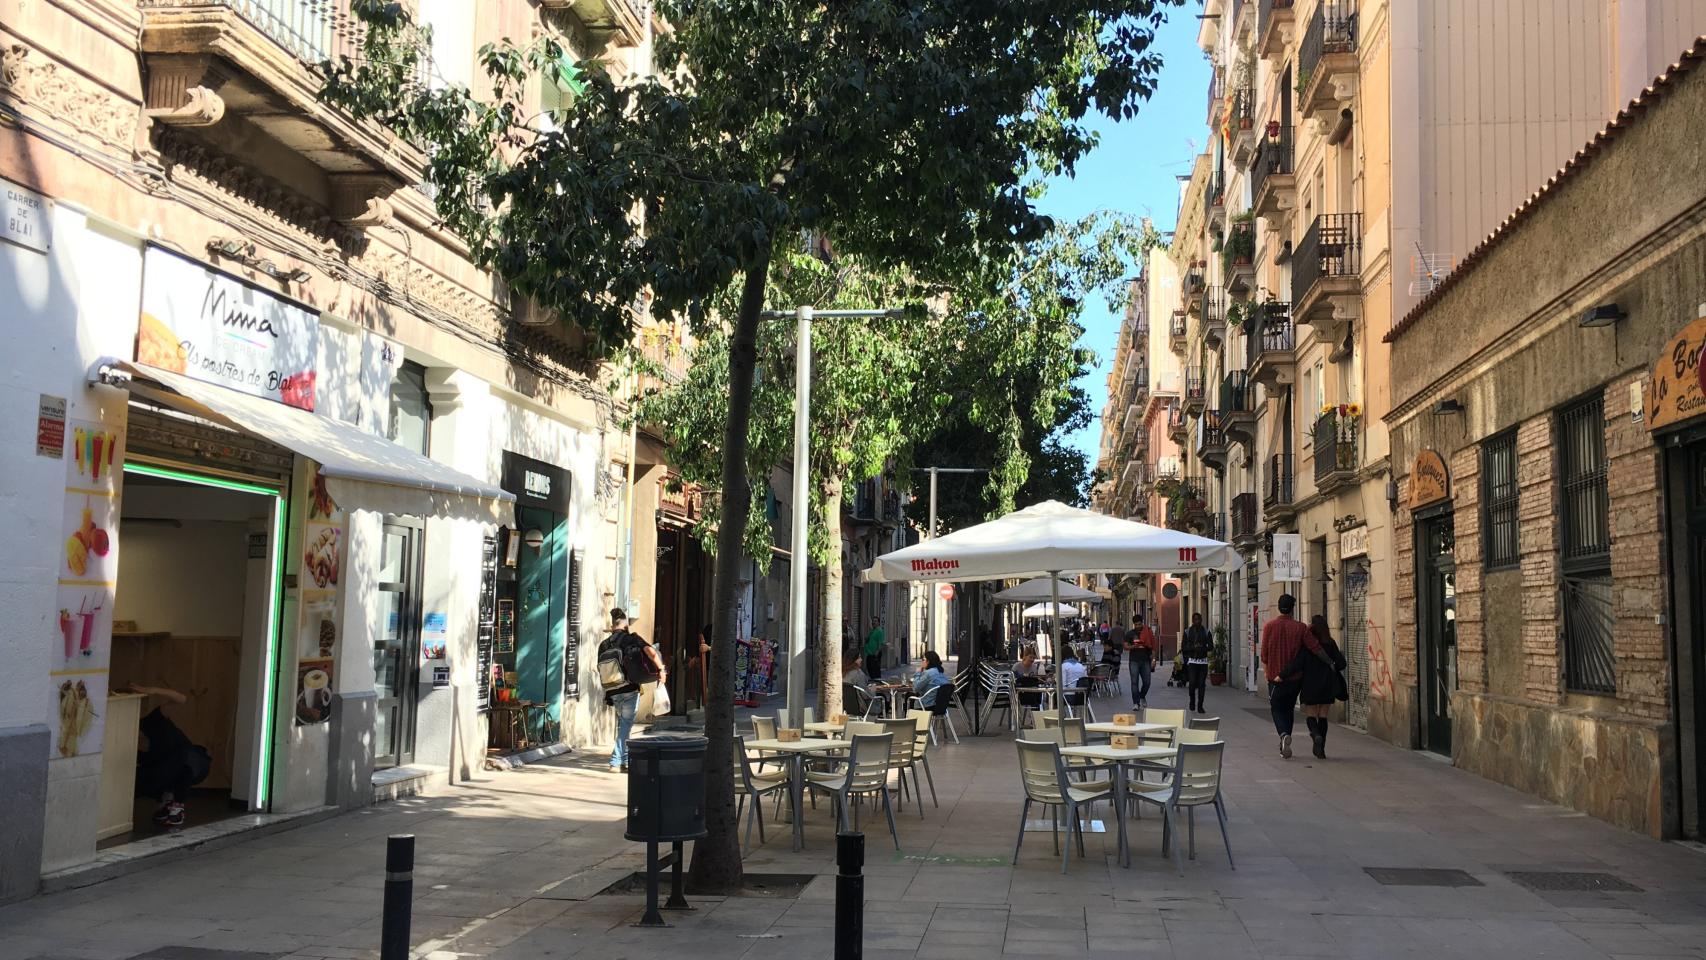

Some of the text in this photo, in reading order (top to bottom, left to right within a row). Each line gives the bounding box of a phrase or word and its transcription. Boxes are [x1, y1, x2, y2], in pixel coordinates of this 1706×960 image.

[7, 190, 40, 209] CARRER
[17, 207, 28, 218] DE
[9, 217, 33, 236] BLAI
[201, 280, 278, 338] Mima
[200, 355, 244, 383] postres
[248, 368, 261, 387] de
[265, 370, 293, 391] Blai
[911, 558, 960, 571] Mahou
[1281, 551, 1289, 560] MI
